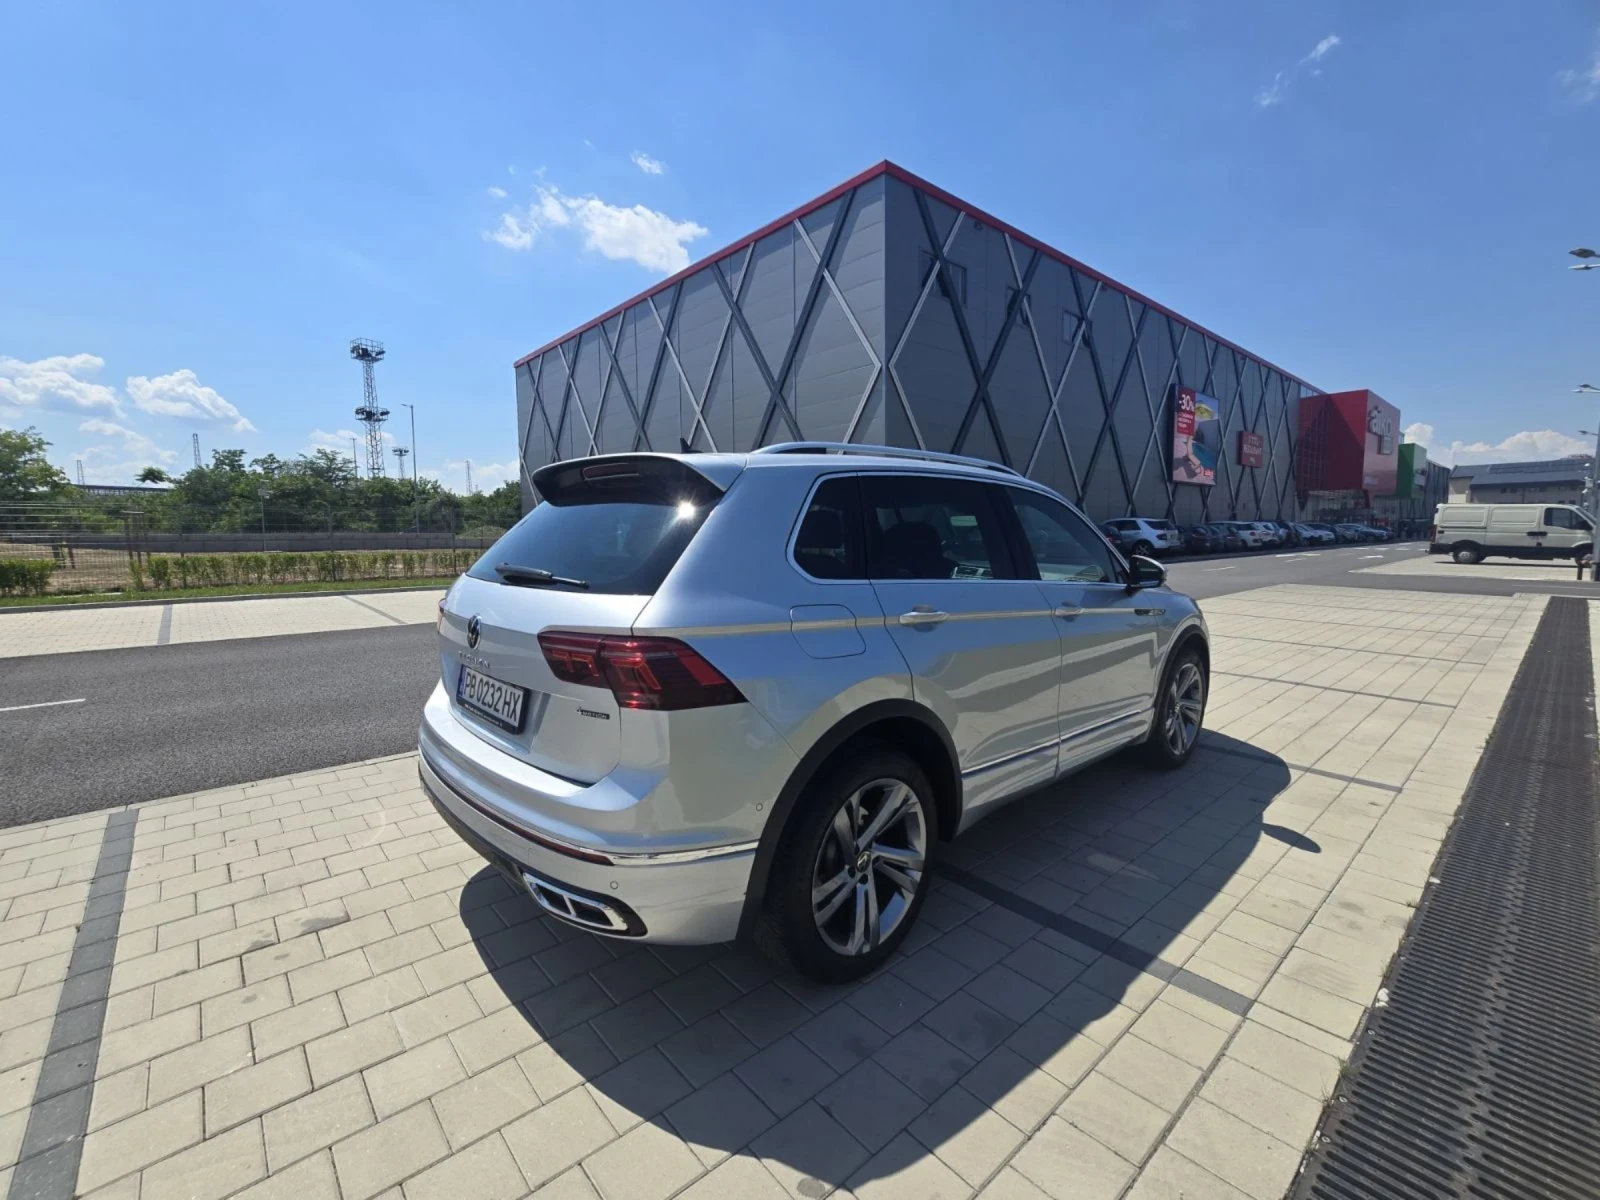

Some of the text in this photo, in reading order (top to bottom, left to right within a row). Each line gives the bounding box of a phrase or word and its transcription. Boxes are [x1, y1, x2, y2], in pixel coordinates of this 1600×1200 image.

[1179, 394, 1195, 411] -30%
[464, 672, 477, 699] PB
[477, 677, 502, 713] 0232
[502, 689, 520, 722] HX
